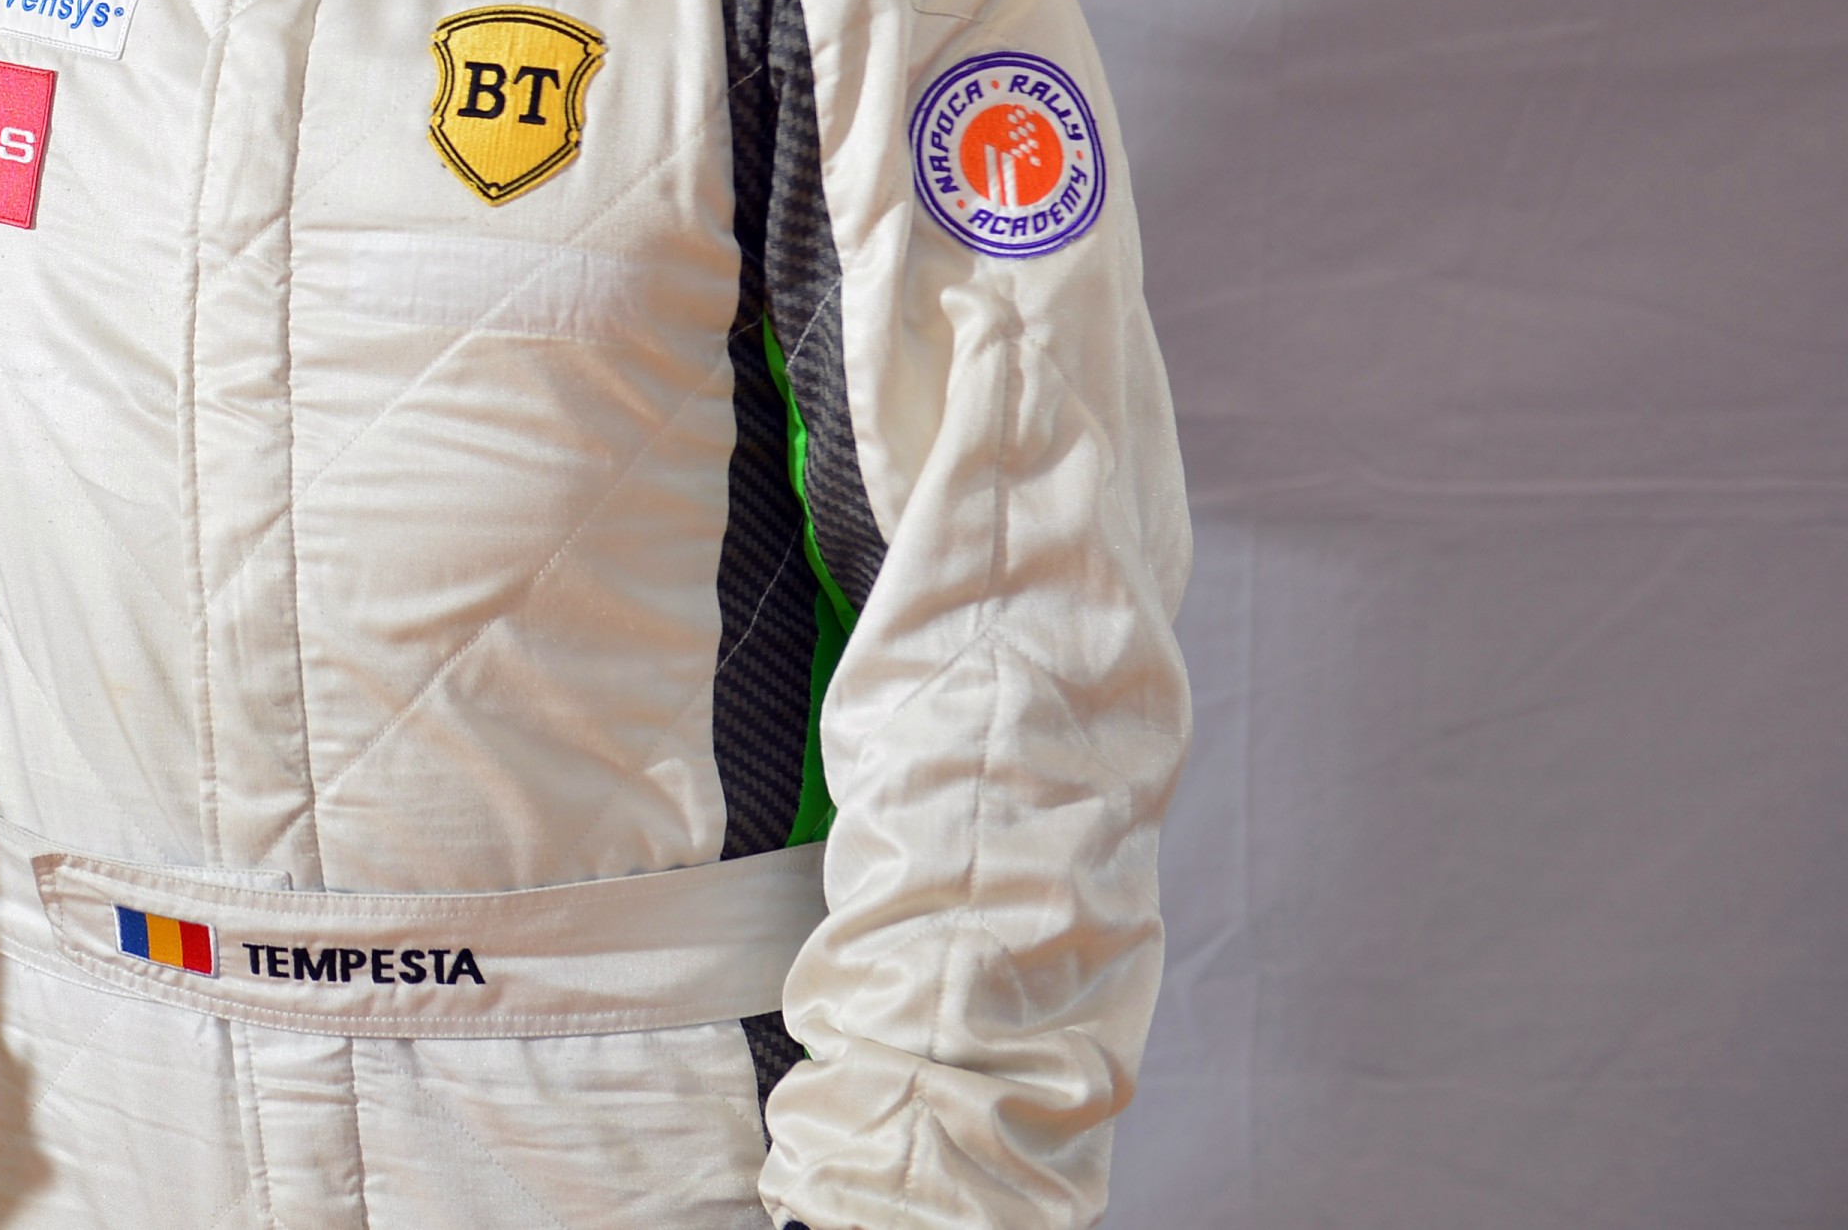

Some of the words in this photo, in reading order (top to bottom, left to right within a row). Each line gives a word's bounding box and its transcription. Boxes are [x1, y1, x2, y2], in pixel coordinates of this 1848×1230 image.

[457, 61, 561, 125] BT
[929, 79, 985, 195] NAPOCA
[1008, 74, 1086, 141] RALLY
[967, 164, 1088, 238] ACADEMY
[241, 941, 487, 986] TEMPESTA
